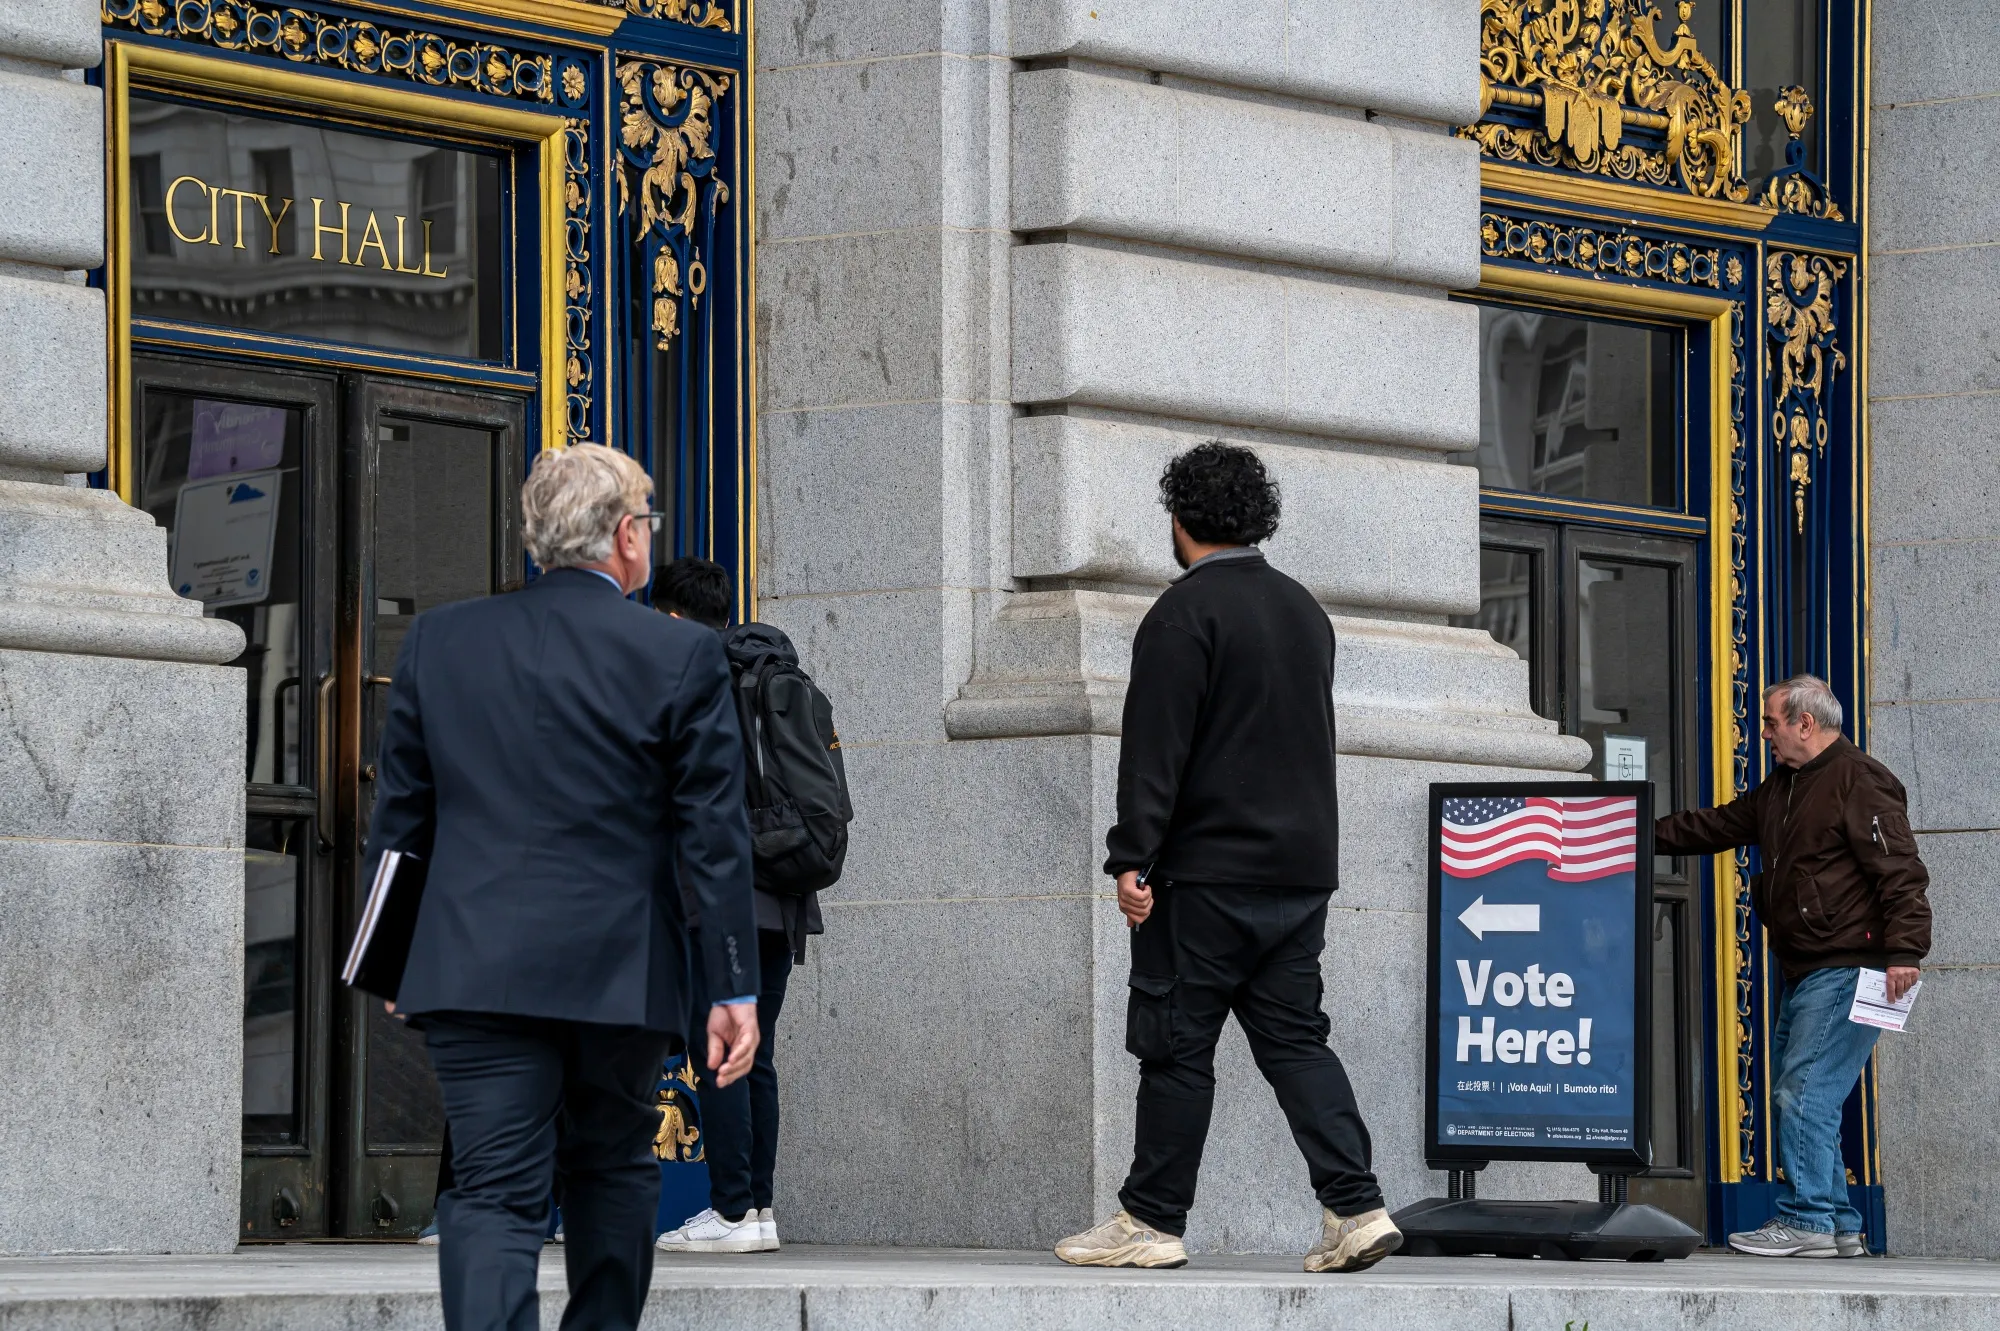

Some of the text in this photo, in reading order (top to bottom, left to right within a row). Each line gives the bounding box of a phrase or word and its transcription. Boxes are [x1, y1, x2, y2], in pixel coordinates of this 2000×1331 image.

[165, 175, 448, 279] CITY HALL
[1456, 959, 1575, 1007] Vote
[1456, 1016, 1593, 1066] Here!
[1507, 1082, 1528, 1094] ¡Vote
[1563, 1083, 1617, 1094] Bumoto rito!
[1457, 1129, 1494, 1137] DEPARTMENT
[1503, 1130, 1536, 1138] ELECTIONS
